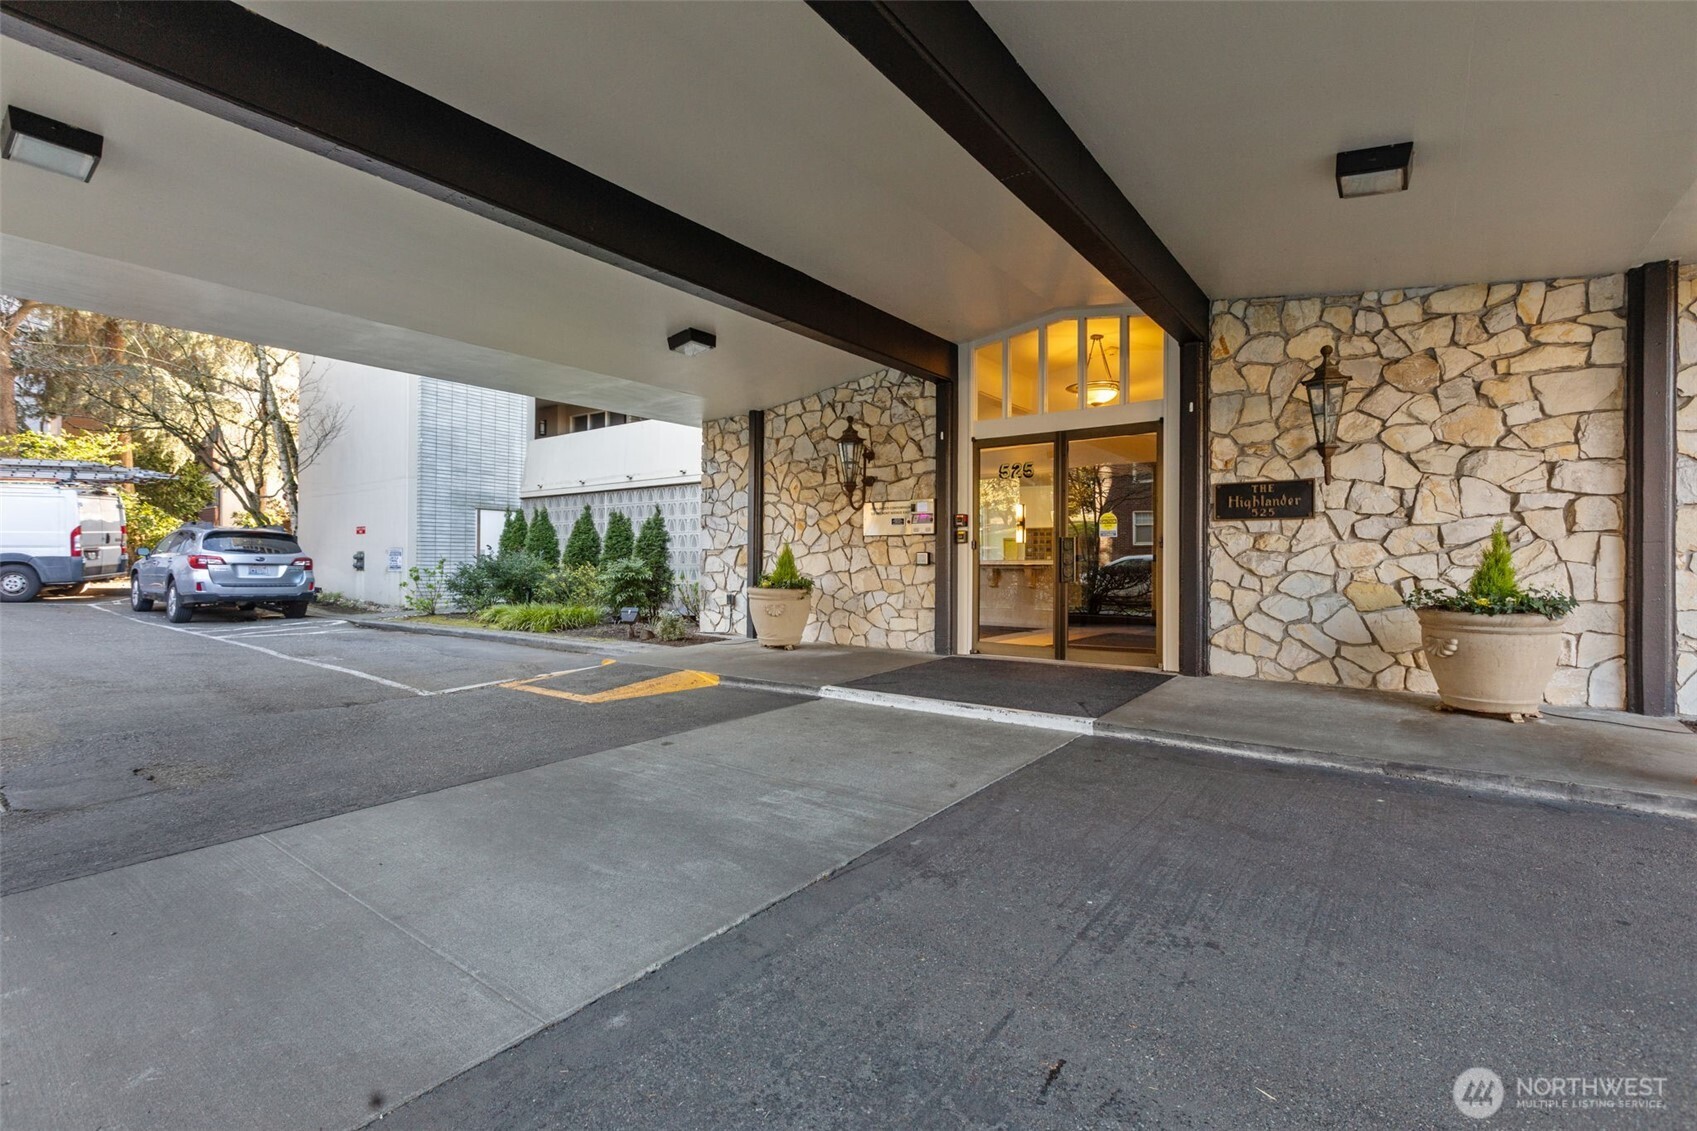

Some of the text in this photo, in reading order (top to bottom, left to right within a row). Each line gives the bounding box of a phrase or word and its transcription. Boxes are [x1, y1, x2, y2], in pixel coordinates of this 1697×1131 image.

[998, 462, 1034, 479] 525
[1251, 484, 1275, 493] THE
[1228, 494, 1302, 510] Highlander
[1251, 508, 1276, 517] 525
